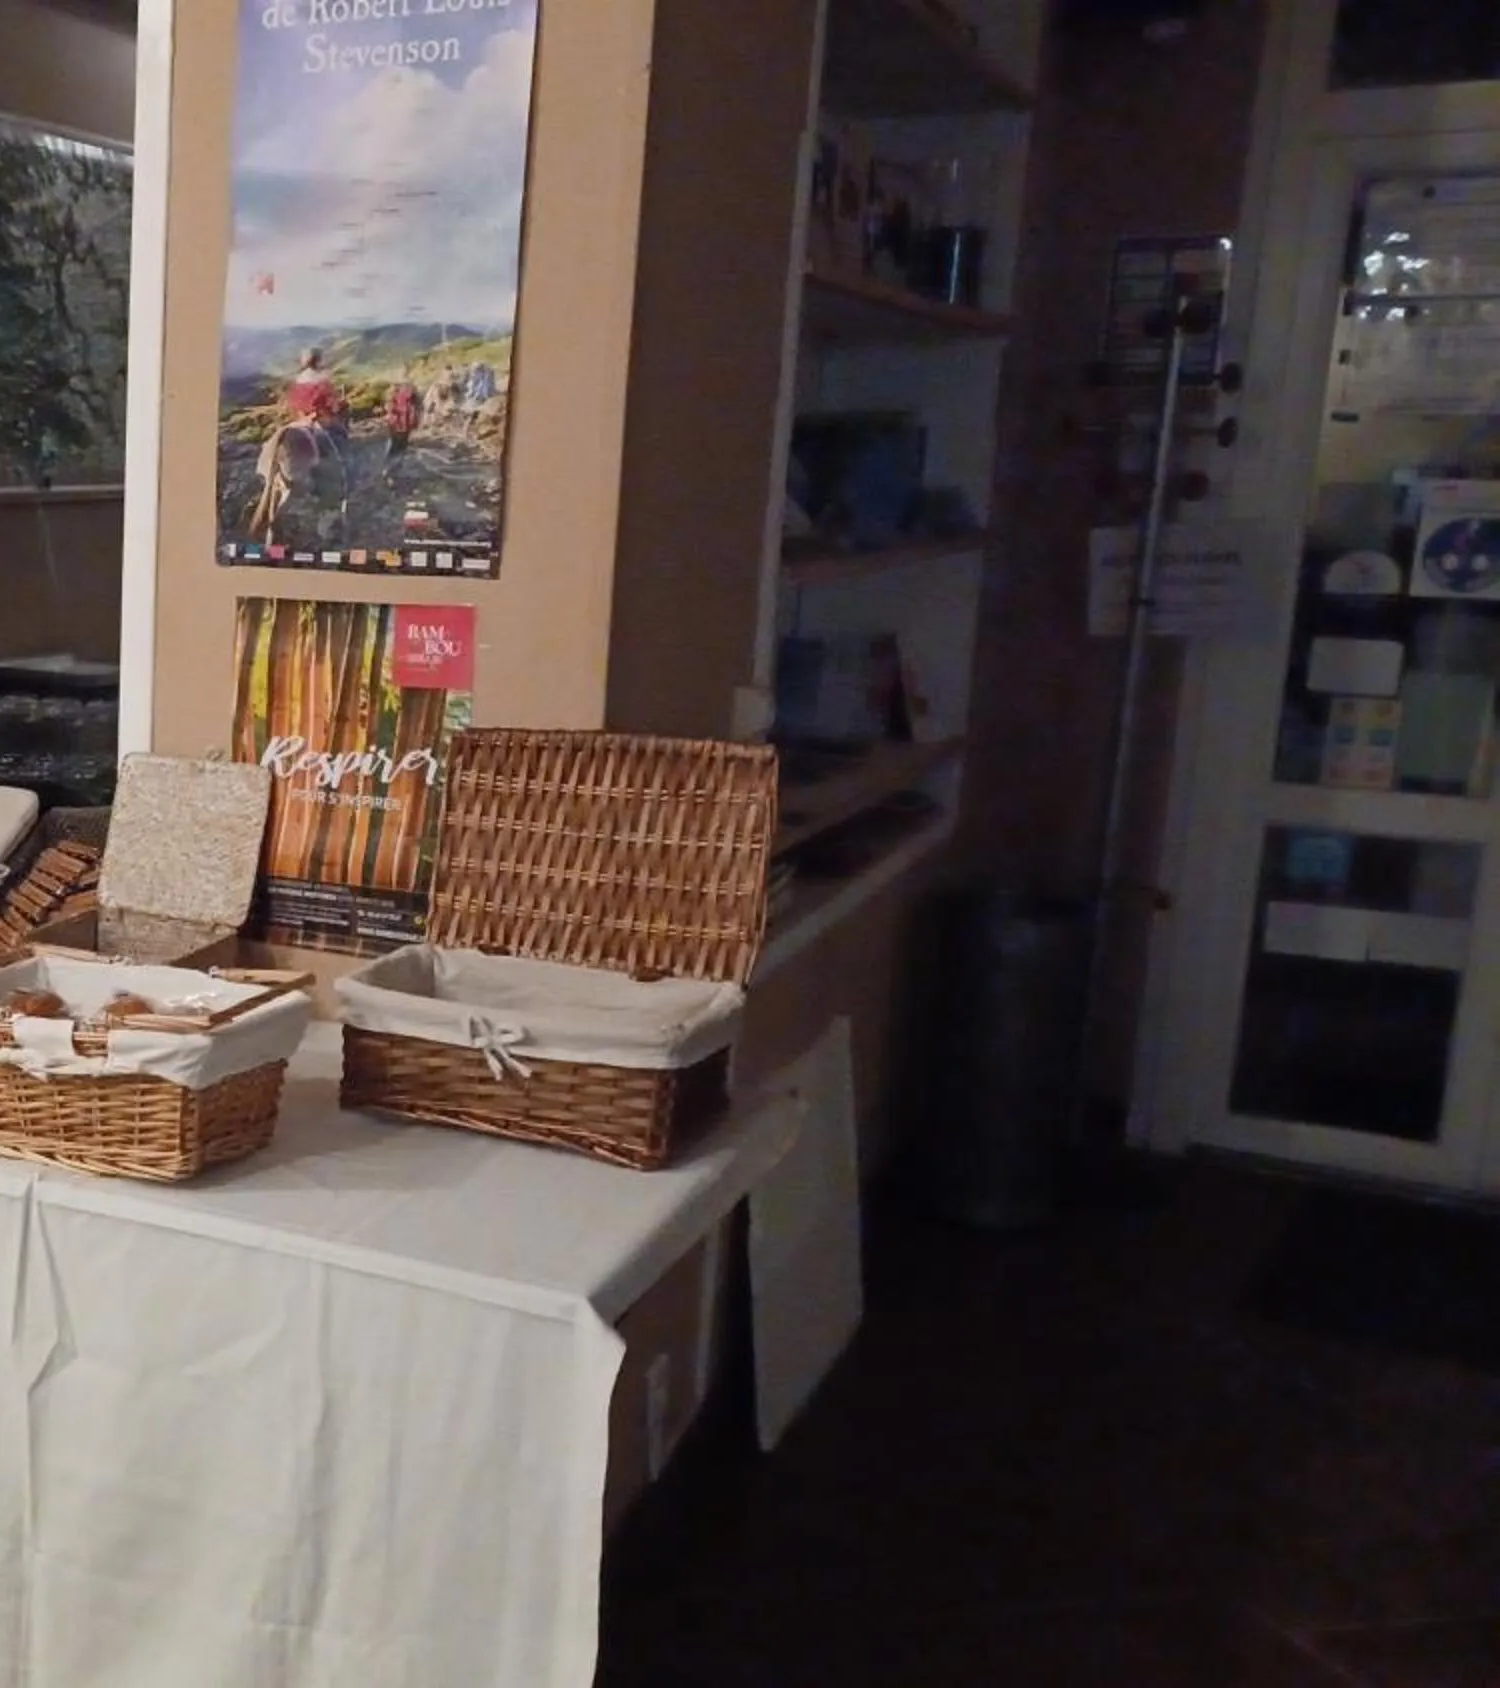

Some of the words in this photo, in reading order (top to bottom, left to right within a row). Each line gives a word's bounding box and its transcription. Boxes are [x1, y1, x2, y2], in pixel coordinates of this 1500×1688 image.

[261, 0, 298, 30] de
[307, 0, 411, 26] Robert
[302, 33, 461, 74] Stevenson
[407, 623, 446, 641] BAM
[260, 735, 438, 790] Respirer
